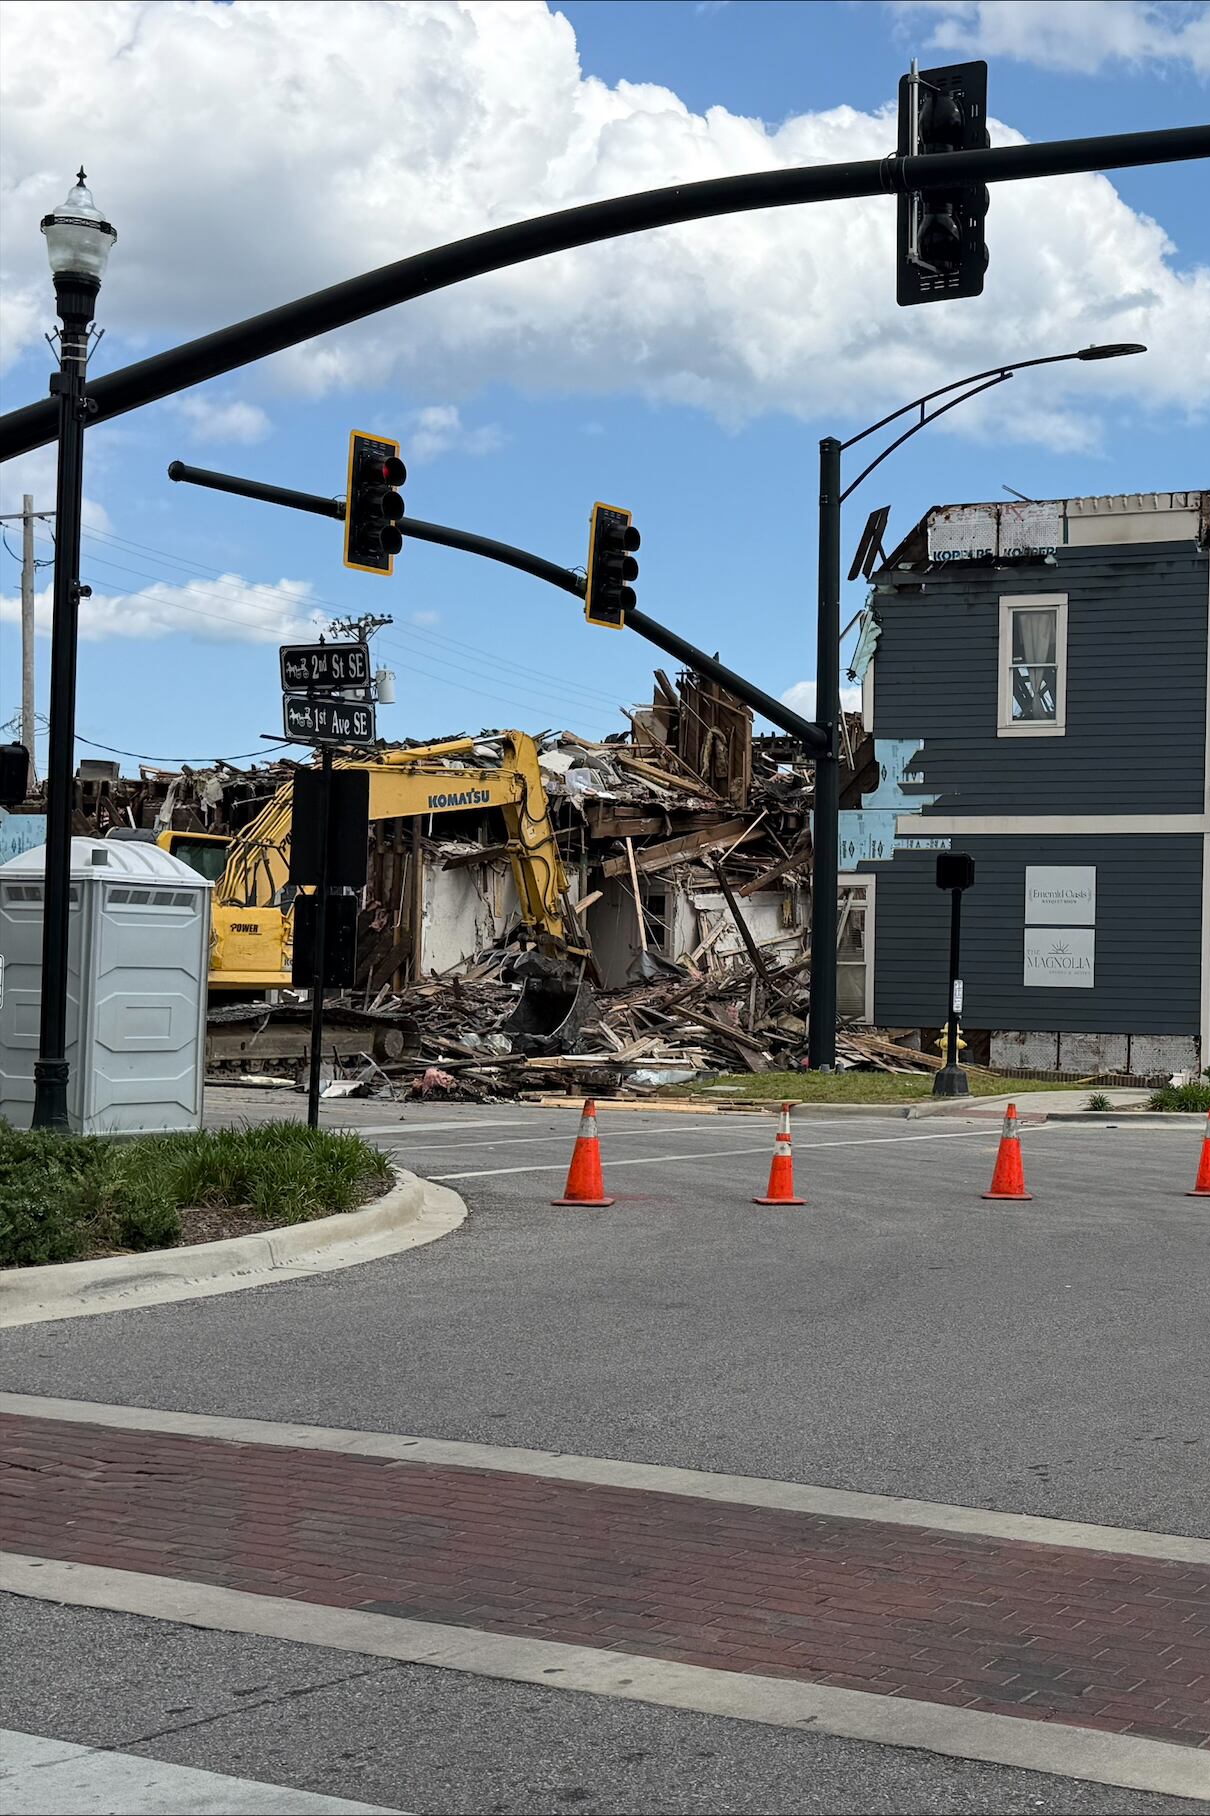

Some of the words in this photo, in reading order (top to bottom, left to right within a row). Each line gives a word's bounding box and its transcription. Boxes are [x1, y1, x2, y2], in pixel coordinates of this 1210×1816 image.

[312, 654, 328, 679] 2nd
[332, 654, 345, 678] St
[348, 653, 364, 678] SE
[314, 708, 327, 732] 1st
[331, 710, 350, 735] Ave
[353, 712, 368, 735] SE
[428, 788, 490, 808] KOMATSU
[230, 923, 259, 933] POWER
[1027, 956, 1091, 969] MAGNOLIA
